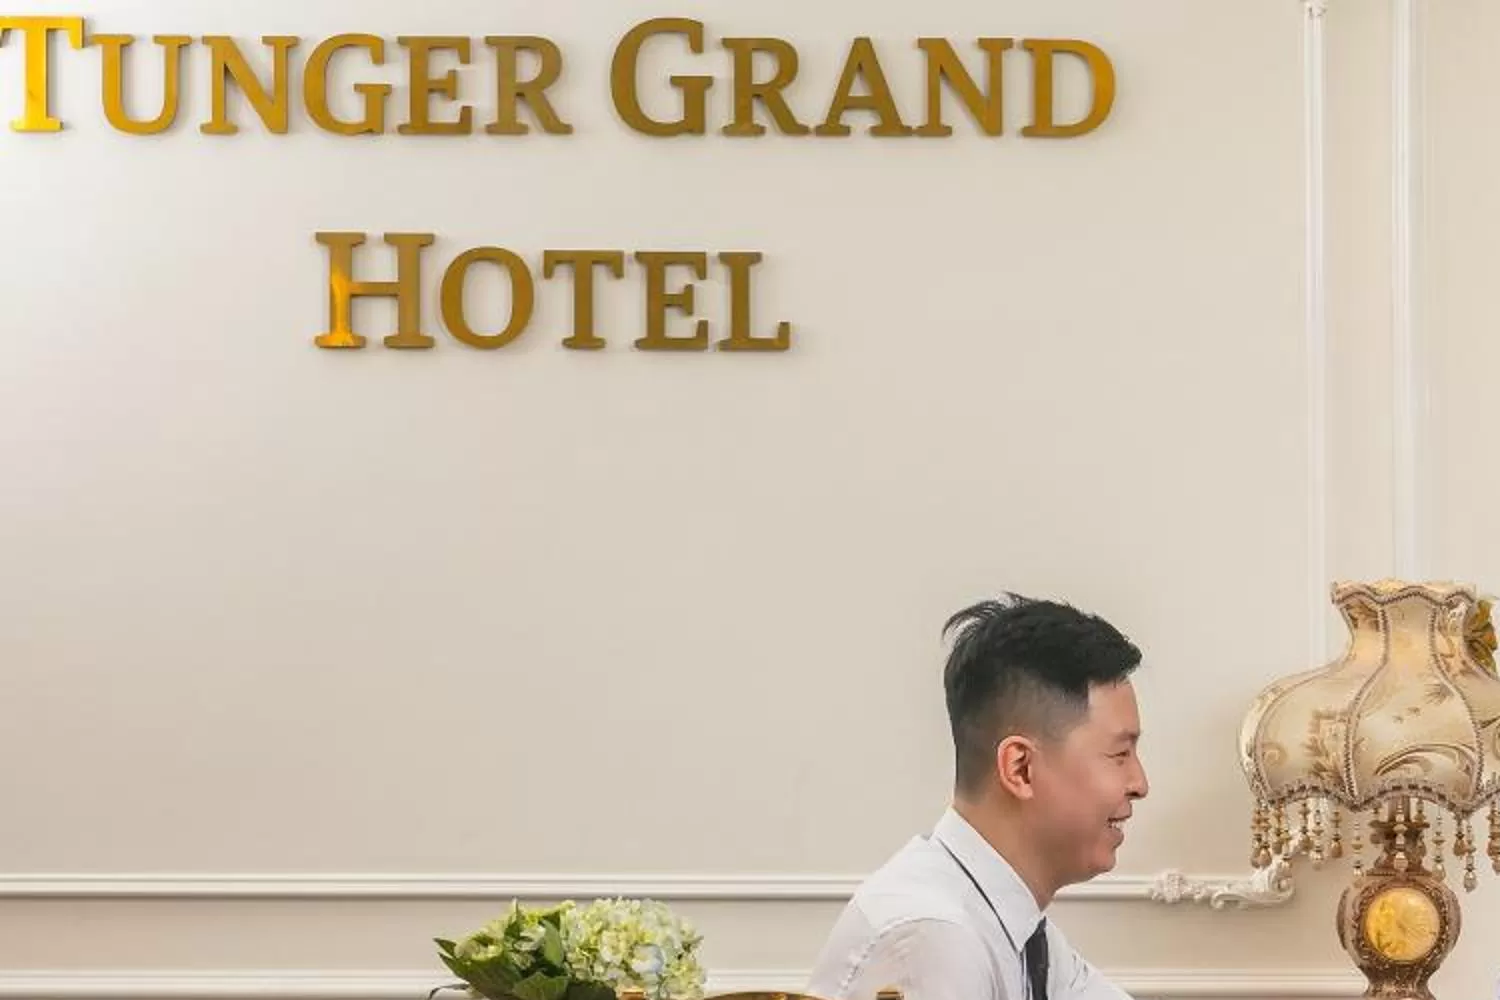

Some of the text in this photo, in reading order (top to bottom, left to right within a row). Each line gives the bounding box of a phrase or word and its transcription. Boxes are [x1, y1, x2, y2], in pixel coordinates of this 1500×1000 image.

[0, 15, 1117, 138] TUNGER GRAND
[313, 231, 791, 352] HOTEL
